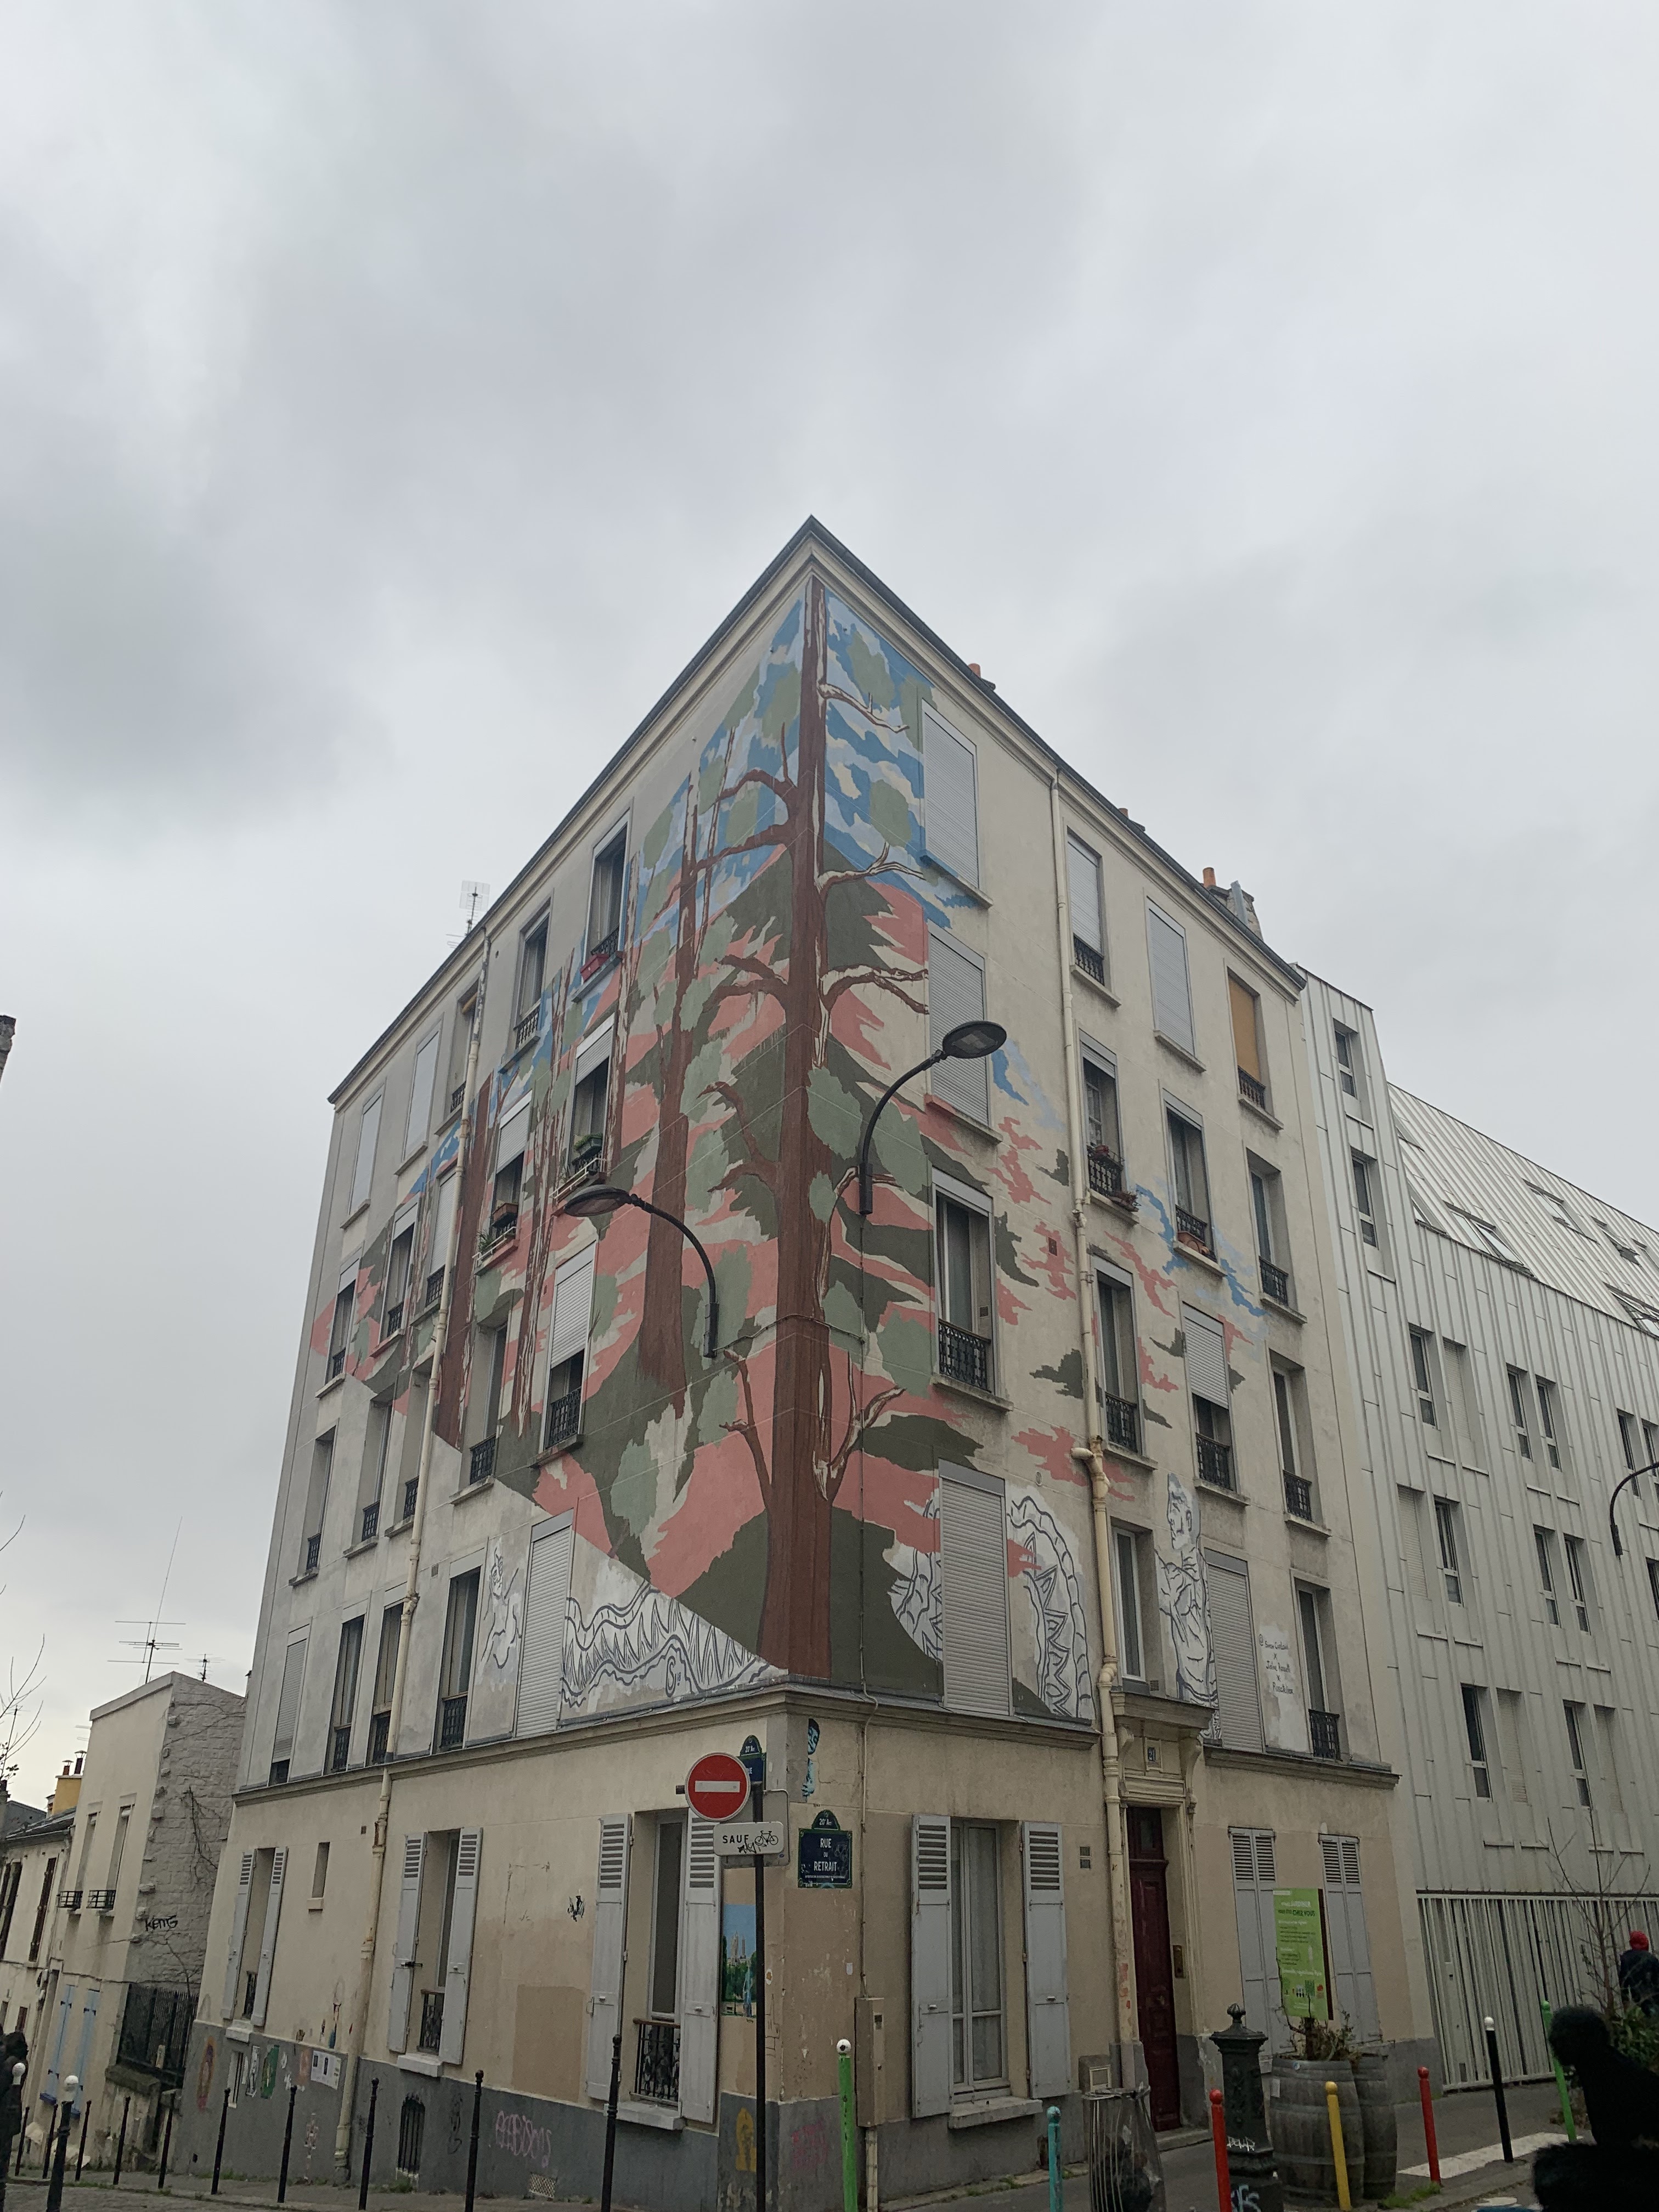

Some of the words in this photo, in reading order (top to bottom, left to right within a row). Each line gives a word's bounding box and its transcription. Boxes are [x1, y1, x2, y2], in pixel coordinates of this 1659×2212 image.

[722, 1835, 749, 1843] SAUF
[820, 1838, 832, 1848] RUE
[814, 1861, 837, 1871] RETRAIT
